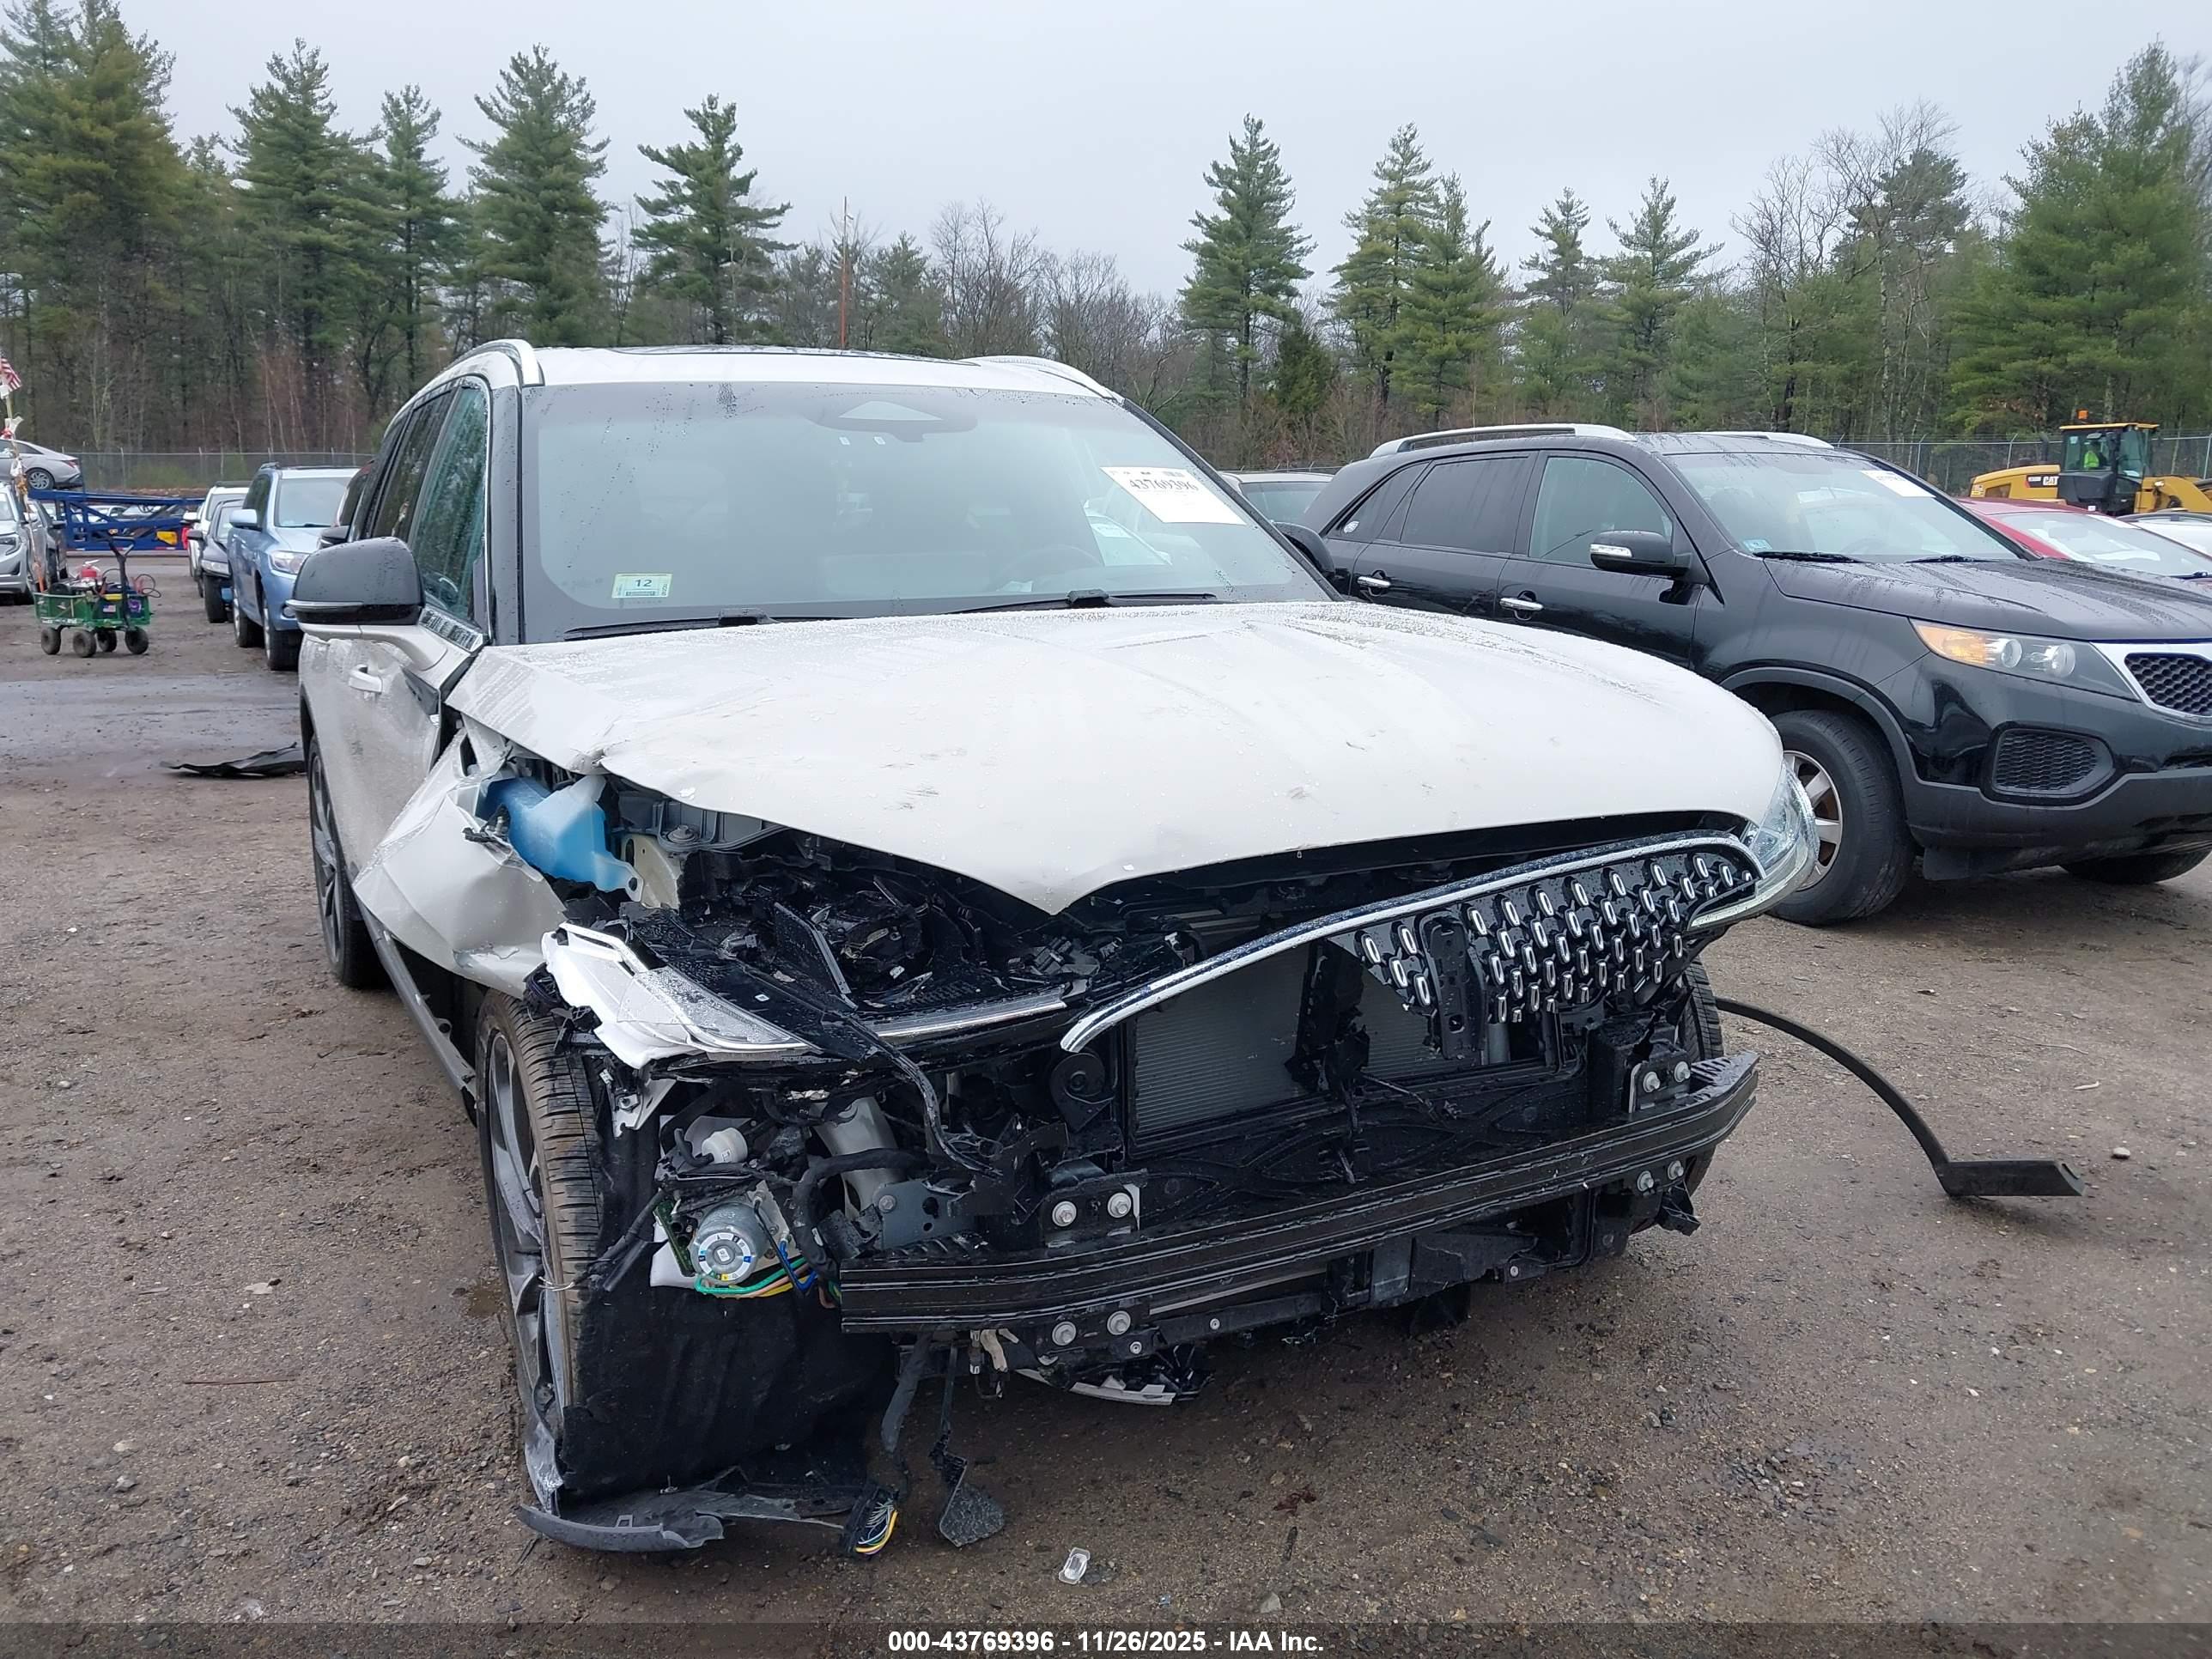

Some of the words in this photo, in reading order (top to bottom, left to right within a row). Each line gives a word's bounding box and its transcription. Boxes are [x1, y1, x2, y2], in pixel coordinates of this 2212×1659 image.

[1128, 478, 1199, 491] 43769396
[2043, 476, 2059, 486] CAT
[635, 579, 653, 587] 12
